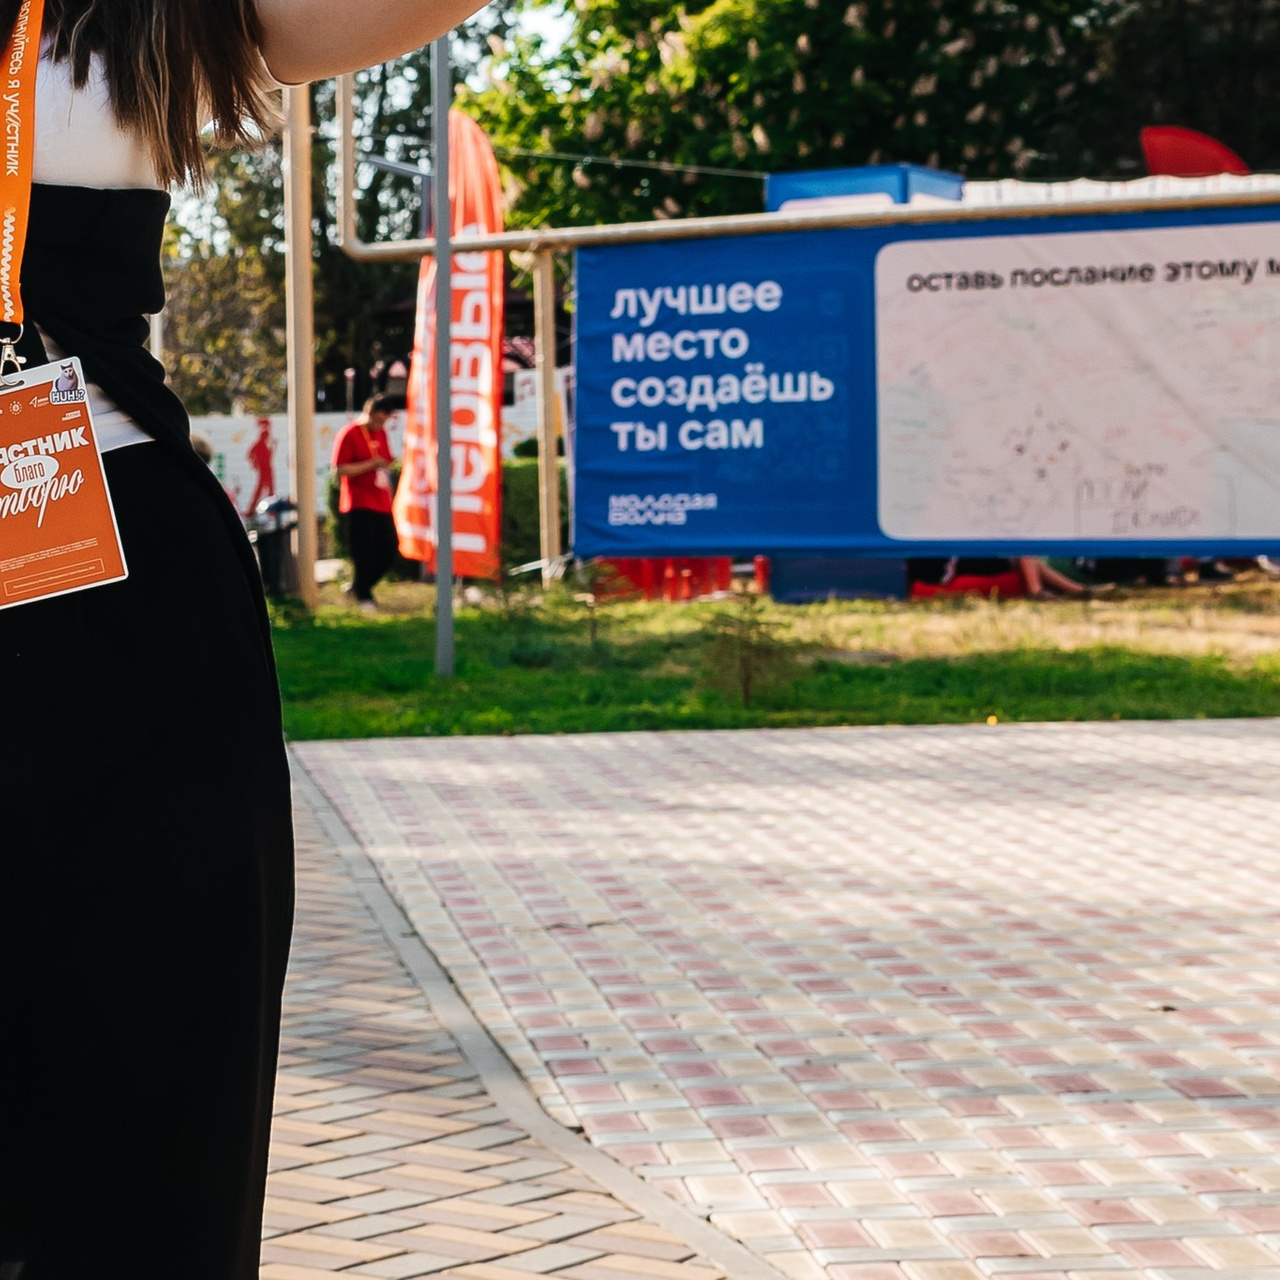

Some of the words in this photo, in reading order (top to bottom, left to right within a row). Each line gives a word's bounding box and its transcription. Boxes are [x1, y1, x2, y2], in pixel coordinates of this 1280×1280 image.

[8, 0, 32, 75] волнуйтесь
[7, 79, 20, 89] я
[2, 92, 22, 176] участник
[906, 271, 1004, 293] оставь
[1010, 263, 1156, 288] послание
[1165, 258, 1259, 285] этому
[610, 280, 783, 327] лучшее
[611, 328, 749, 363] место
[51, 389, 86, 403] HUH!?
[610, 362, 835, 412] создаёшь
[610, 422, 668, 451] ты
[678, 419, 764, 450] сам
[13, 461, 45, 484] благо
